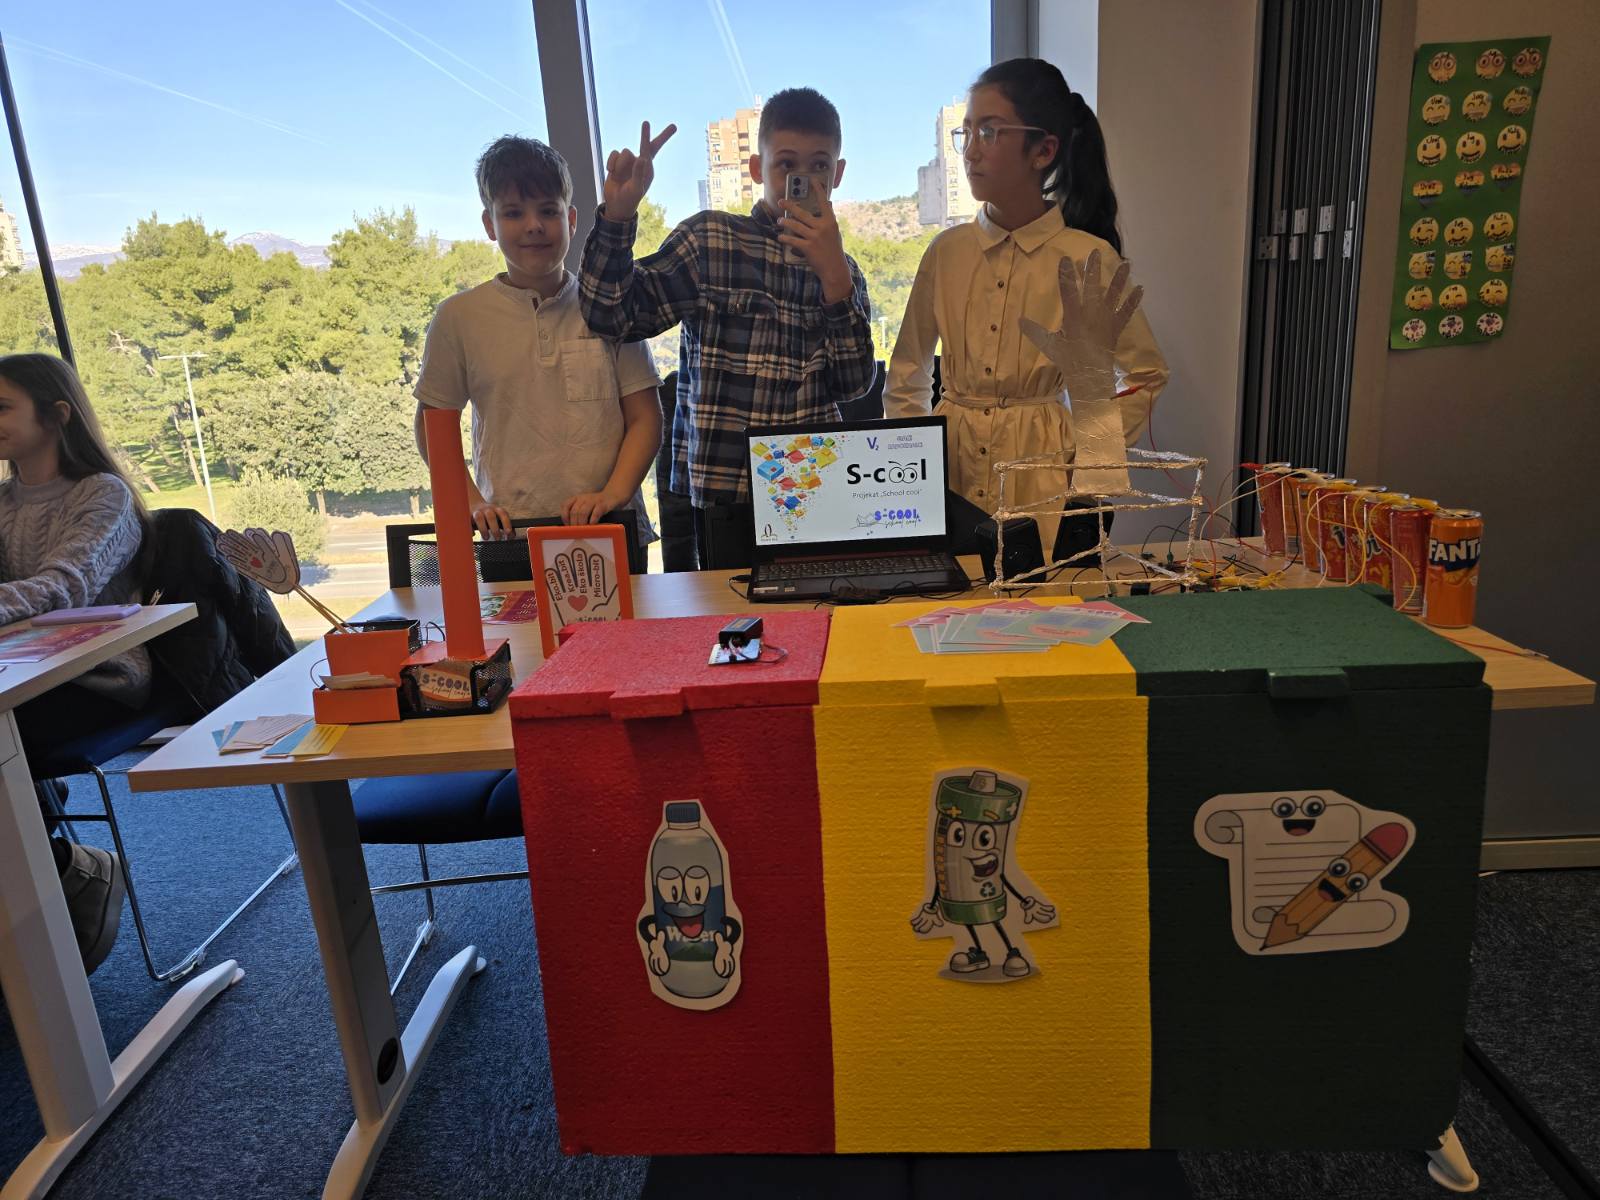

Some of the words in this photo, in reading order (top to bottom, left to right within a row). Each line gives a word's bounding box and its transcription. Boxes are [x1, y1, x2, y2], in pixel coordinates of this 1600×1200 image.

[576, 553, 586, 577] škola
[579, 579, 588, 594] Eko
[665, 926, 717, 943] Wer
